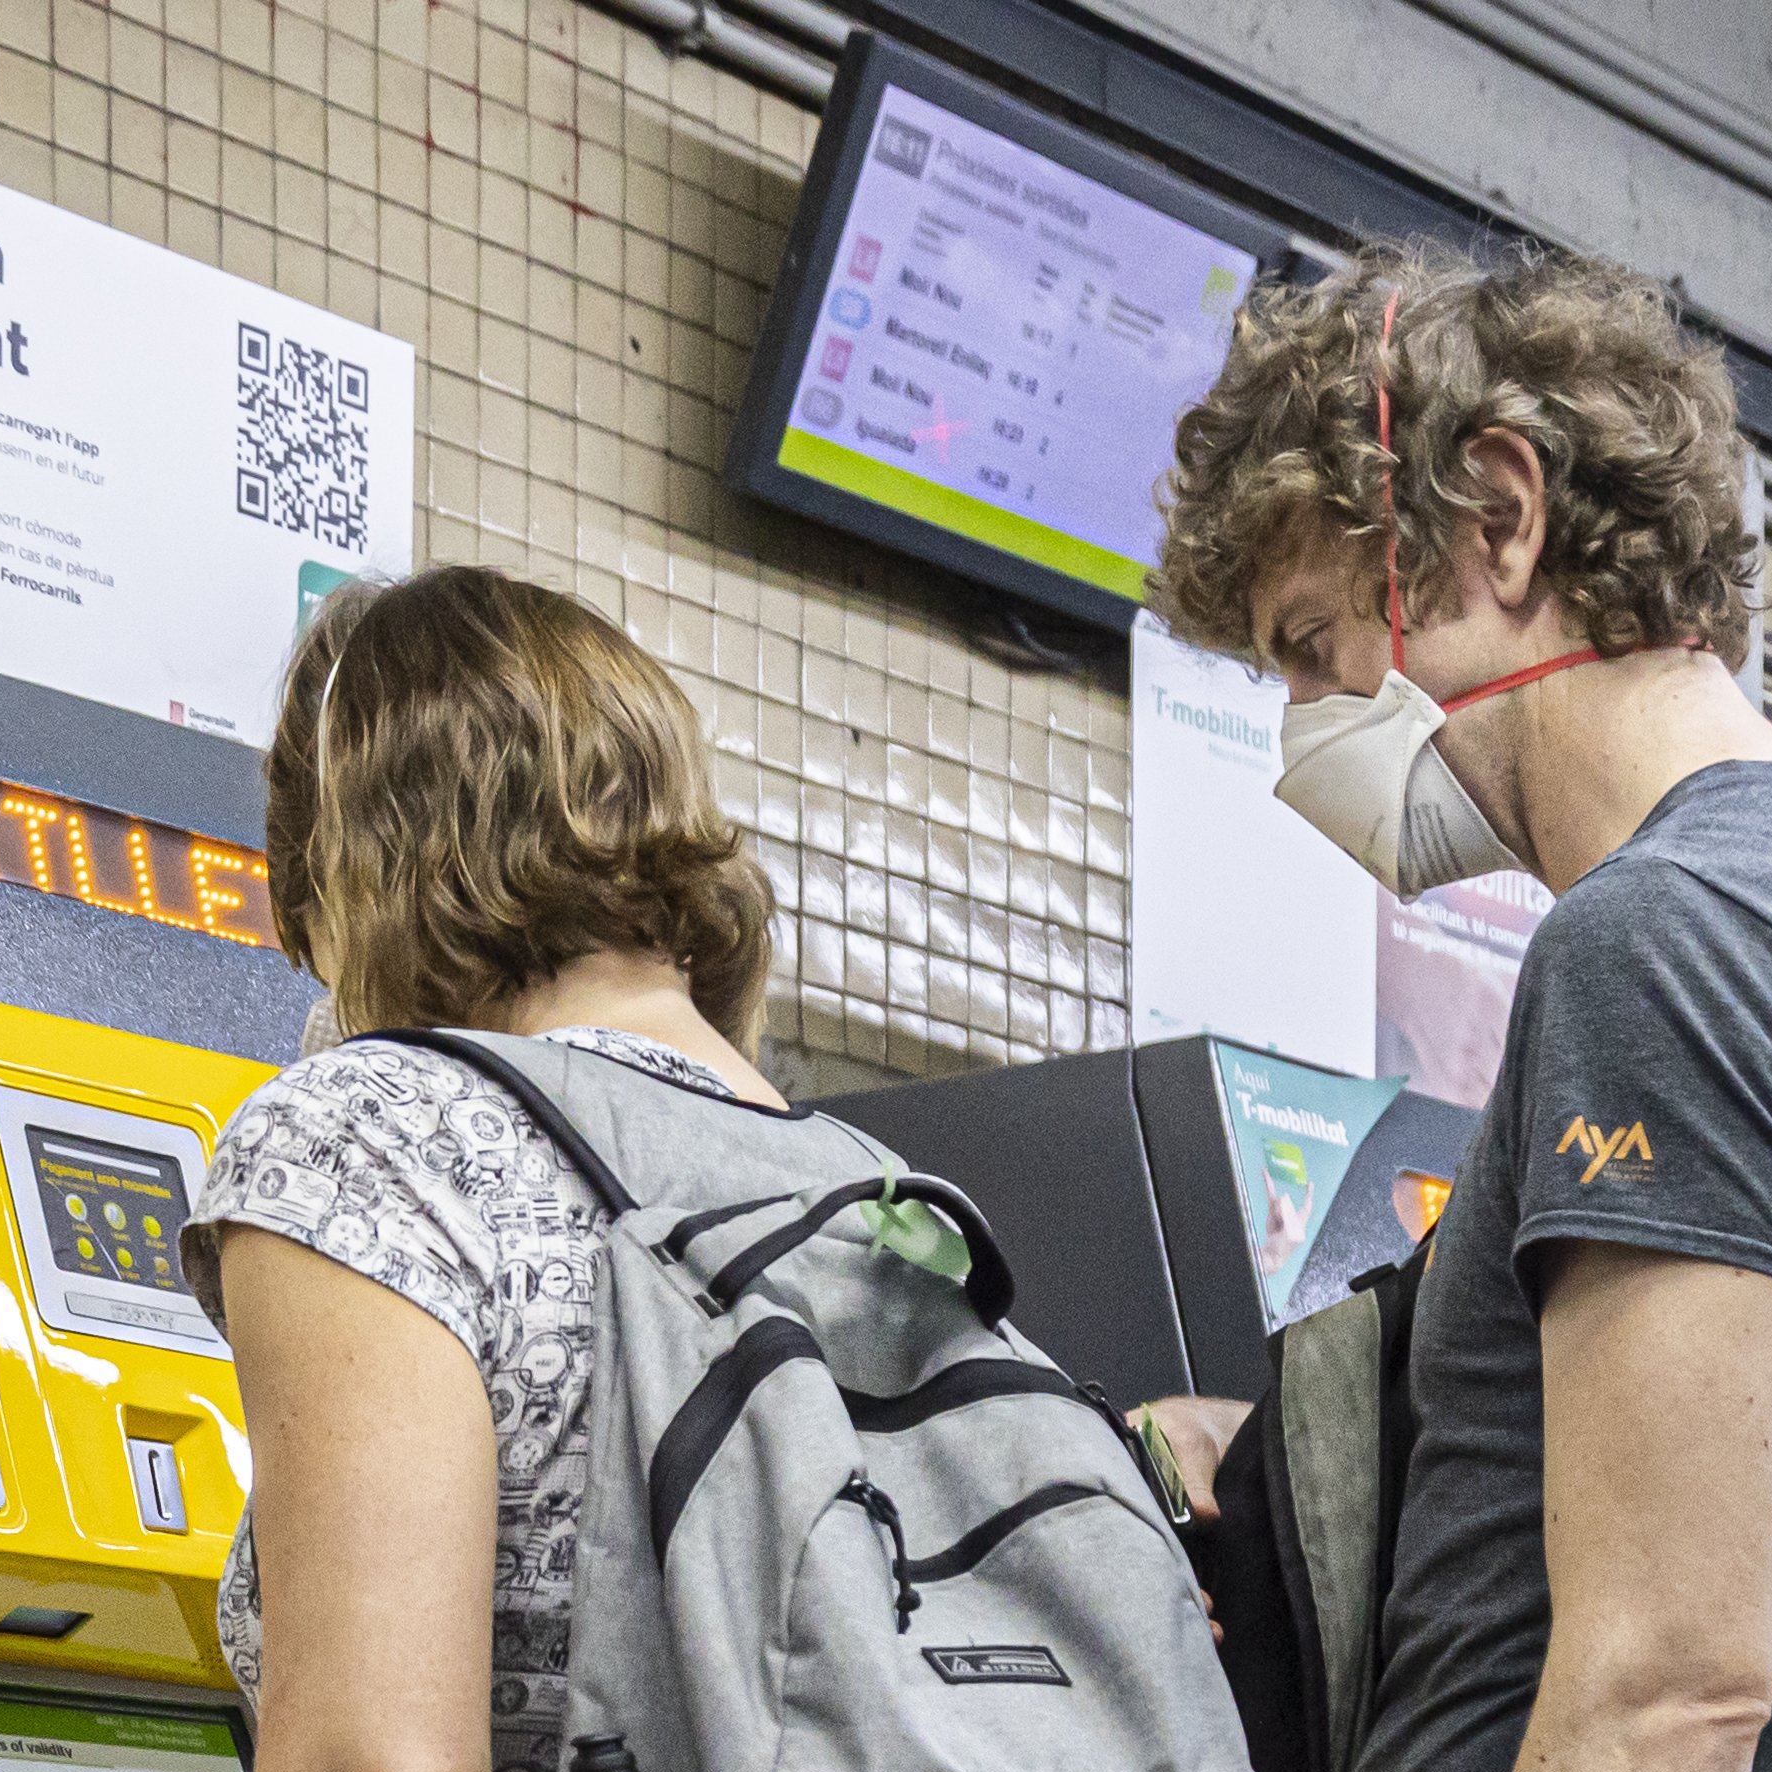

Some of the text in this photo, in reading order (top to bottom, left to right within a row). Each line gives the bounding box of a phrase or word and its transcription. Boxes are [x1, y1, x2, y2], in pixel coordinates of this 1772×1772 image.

[65, 432, 100, 459] l'app
[36, 452, 53, 470] en
[57, 459, 69, 474] el
[72, 462, 105, 487] futur
[19, 547, 42, 565] cas
[45, 553, 63, 571] de
[1151, 682, 1272, 753] T-mobilitat
[1234, 1060, 1271, 1095] Aquí
[1235, 1089, 1350, 1147] T-mobilitat
[39, 1157, 94, 1182] Pagament
[11, 1740, 25, 1753] of
[27, 1743, 73, 1759] validity
